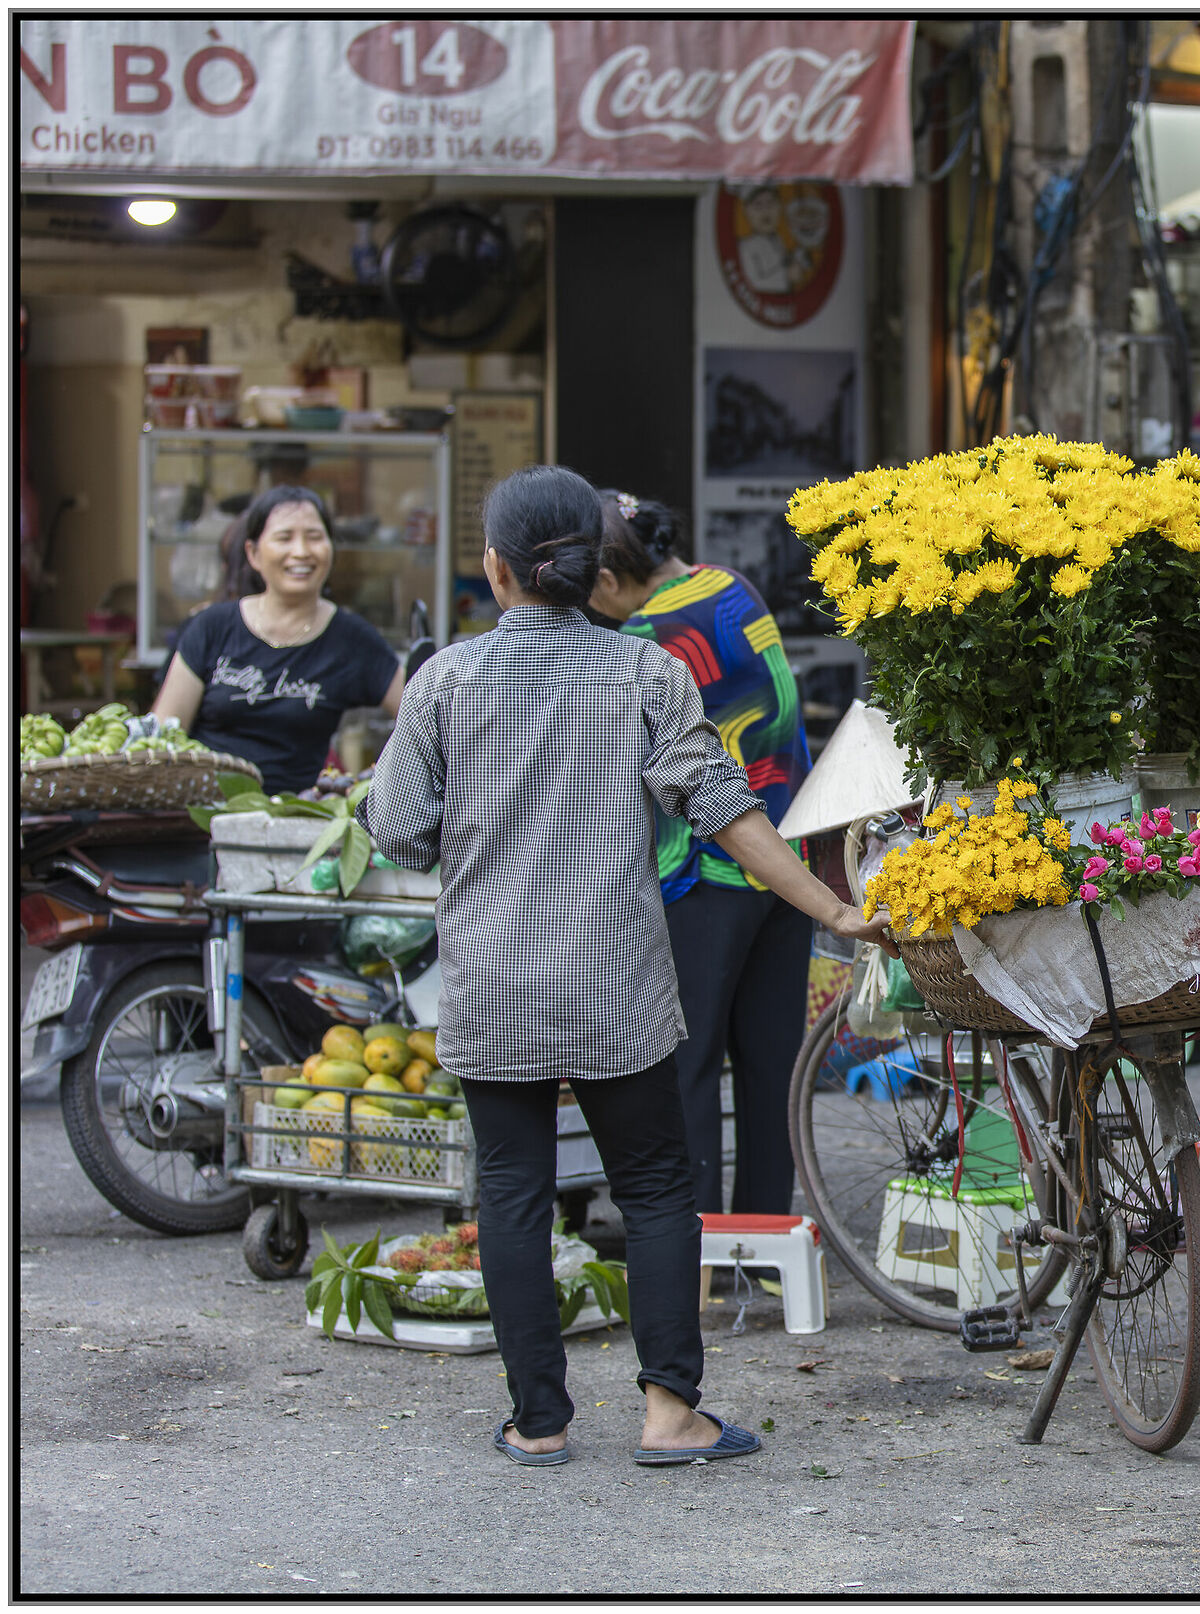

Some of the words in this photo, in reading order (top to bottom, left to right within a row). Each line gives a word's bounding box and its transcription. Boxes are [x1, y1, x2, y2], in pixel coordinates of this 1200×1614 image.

[112, 27, 258, 118] BÒ
[391, 26, 466, 88] 14
[31, 125, 157, 154] Chicken
[368, 135, 436, 159] 0983
[445, 138, 482, 159] 114
[492, 138, 544, 161] 466
